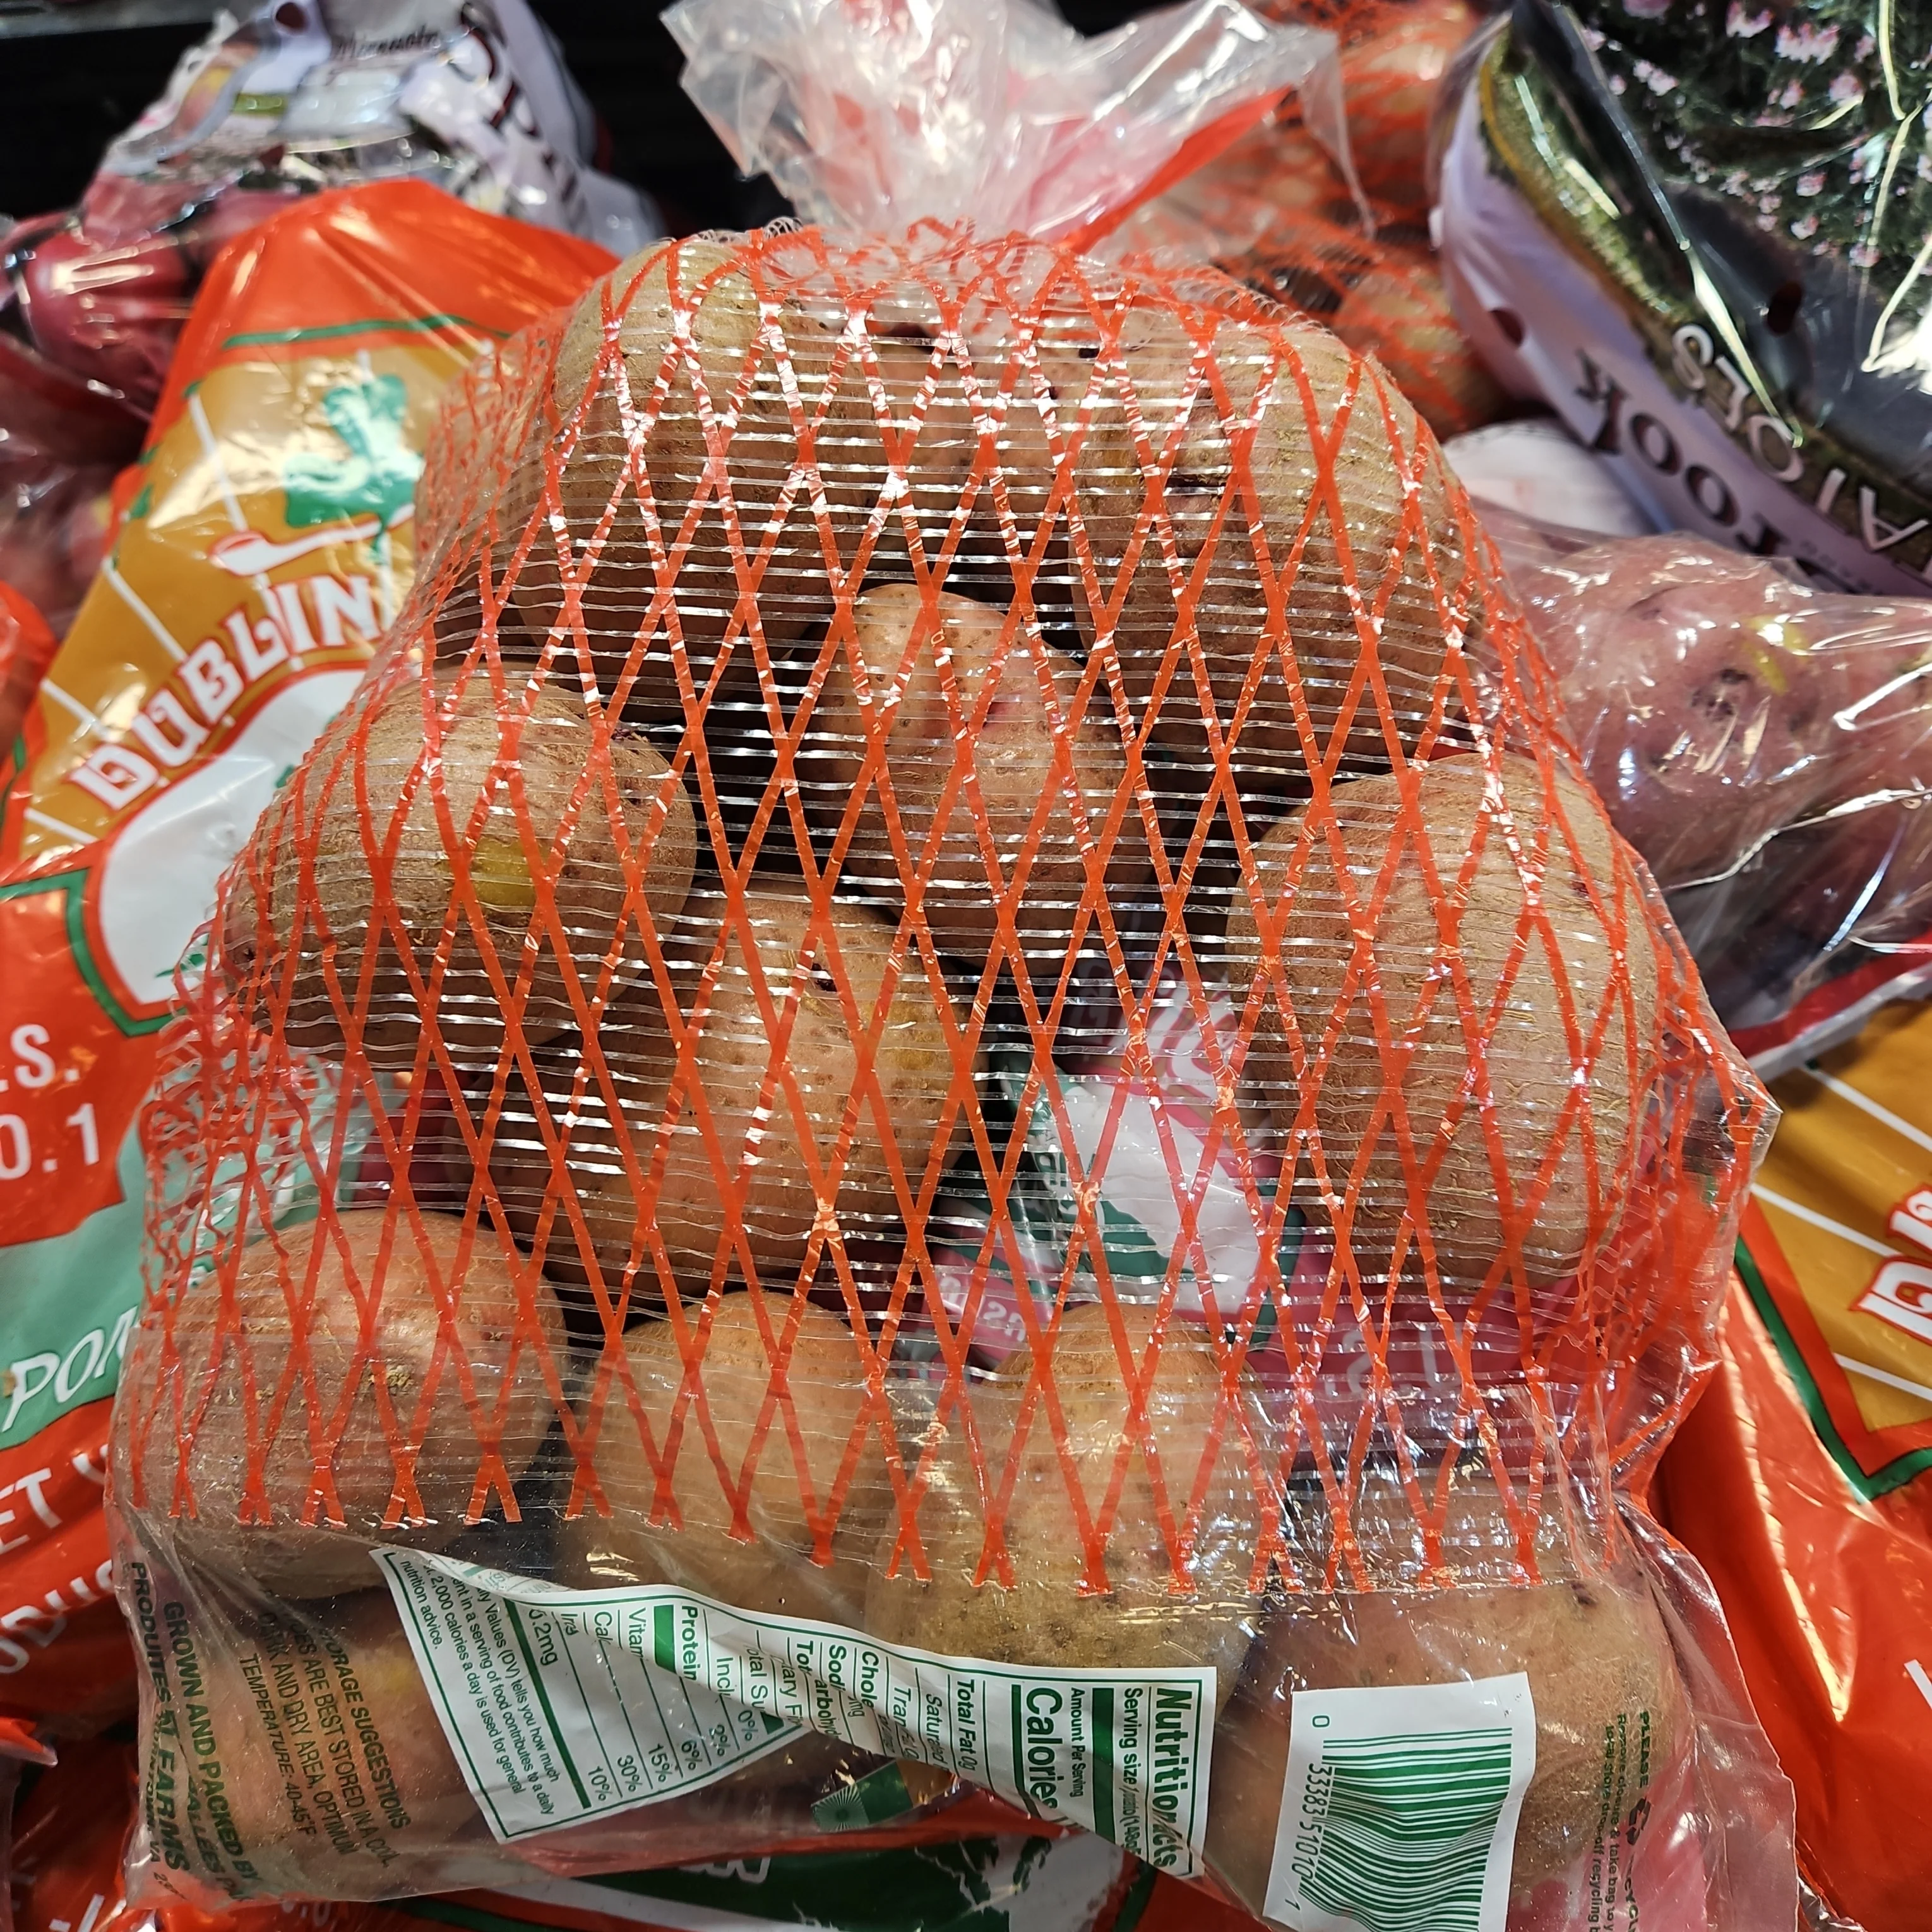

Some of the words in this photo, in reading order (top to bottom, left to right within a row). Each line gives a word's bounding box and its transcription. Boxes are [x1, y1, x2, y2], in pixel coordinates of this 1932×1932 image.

[68, 575, 378, 811] DUBLIN
[400, 1560, 428, 1604] nutrition
[420, 1604, 443, 1650] advice.
[430, 1575, 454, 1610] 2,000
[460, 1597, 474, 1611] in
[131, 1562, 172, 1703] PRODUITES
[465, 1612, 476, 1623] a
[485, 1602, 506, 1648] Values
[163, 1601, 205, 1698] GROWN
[444, 1611, 469, 1661] calories
[470, 1623, 493, 1669] serving
[681, 1606, 701, 1681] Protein
[271, 1663, 300, 1698] AND
[302, 1659, 330, 1693] ARE
[462, 1661, 474, 1672] a
[486, 1670, 503, 1684] of
[497, 1649, 521, 1679] (DV)
[466, 1672, 483, 1695] day
[491, 1683, 513, 1711] food
[511, 1678, 528, 1703] tells
[239, 1652, 295, 1778] TEMPERATURE:
[283, 1698, 313, 1736] DRY
[314, 1693, 345, 1736] BEST
[475, 1695, 488, 1708] is
[517, 1703, 536, 1726] you
[957, 1679, 975, 1725] Total
[1070, 1687, 1085, 1742] Amount
[1118, 1688, 1143, 1748] Serving
[186, 1703, 216, 1756] AND
[480, 1708, 503, 1738] used
[530, 1726, 547, 1751] how
[737, 1709, 758, 1742] 0%
[1312, 1715, 1330, 1728] 0
[492, 1736, 507, 1753] for
[502, 1711, 534, 1772] contributes
[681, 1739, 703, 1771] 6%
[708, 1724, 730, 1756] 2%
[958, 1727, 977, 1755] Fat
[1071, 1745, 1086, 1762] Per
[1151, 1687, 1193, 1823] Nutrition
[1617, 1713, 1626, 1773] Remove
[1640, 1710, 1650, 1789] PLEASE
[294, 1740, 326, 1789] AREA,
[328, 1739, 366, 1808] STORED
[350, 1707, 411, 1828] SUGGESTIONS
[496, 1755, 527, 1794] general
[527, 1771, 539, 1782] to
[539, 1752, 561, 1782] much
[617, 1755, 643, 1792] 30%
[648, 1743, 673, 1782] 15%
[958, 1755, 978, 1771] 0g
[1123, 1753, 1142, 1785] size
[532, 1783, 543, 1792] a
[588, 1765, 613, 1801] 10%
[1069, 1763, 1087, 1798] Serving
[1301, 1762, 1333, 1817] 33383
[156, 1749, 190, 1871] FARMS
[198, 1760, 244, 1856] PACKED
[536, 1792, 555, 1815] daily
[1611, 1775, 1626, 1825] closure
[313, 1791, 359, 1855] OPTIMUM
[350, 1810, 375, 1826] IN
[359, 1827, 379, 1839] A
[1592, 1803, 1610, 1855] drop-off
[149, 1840, 161, 1862] VA
[1291, 1820, 1323, 1880] 51010
[1609, 1844, 1620, 1875] take
[232, 1859, 261, 1881] BY
[1284, 1898, 1301, 1912] 1
[1587, 1857, 1604, 1923] recycling
[1605, 1876, 1619, 1904] bag
